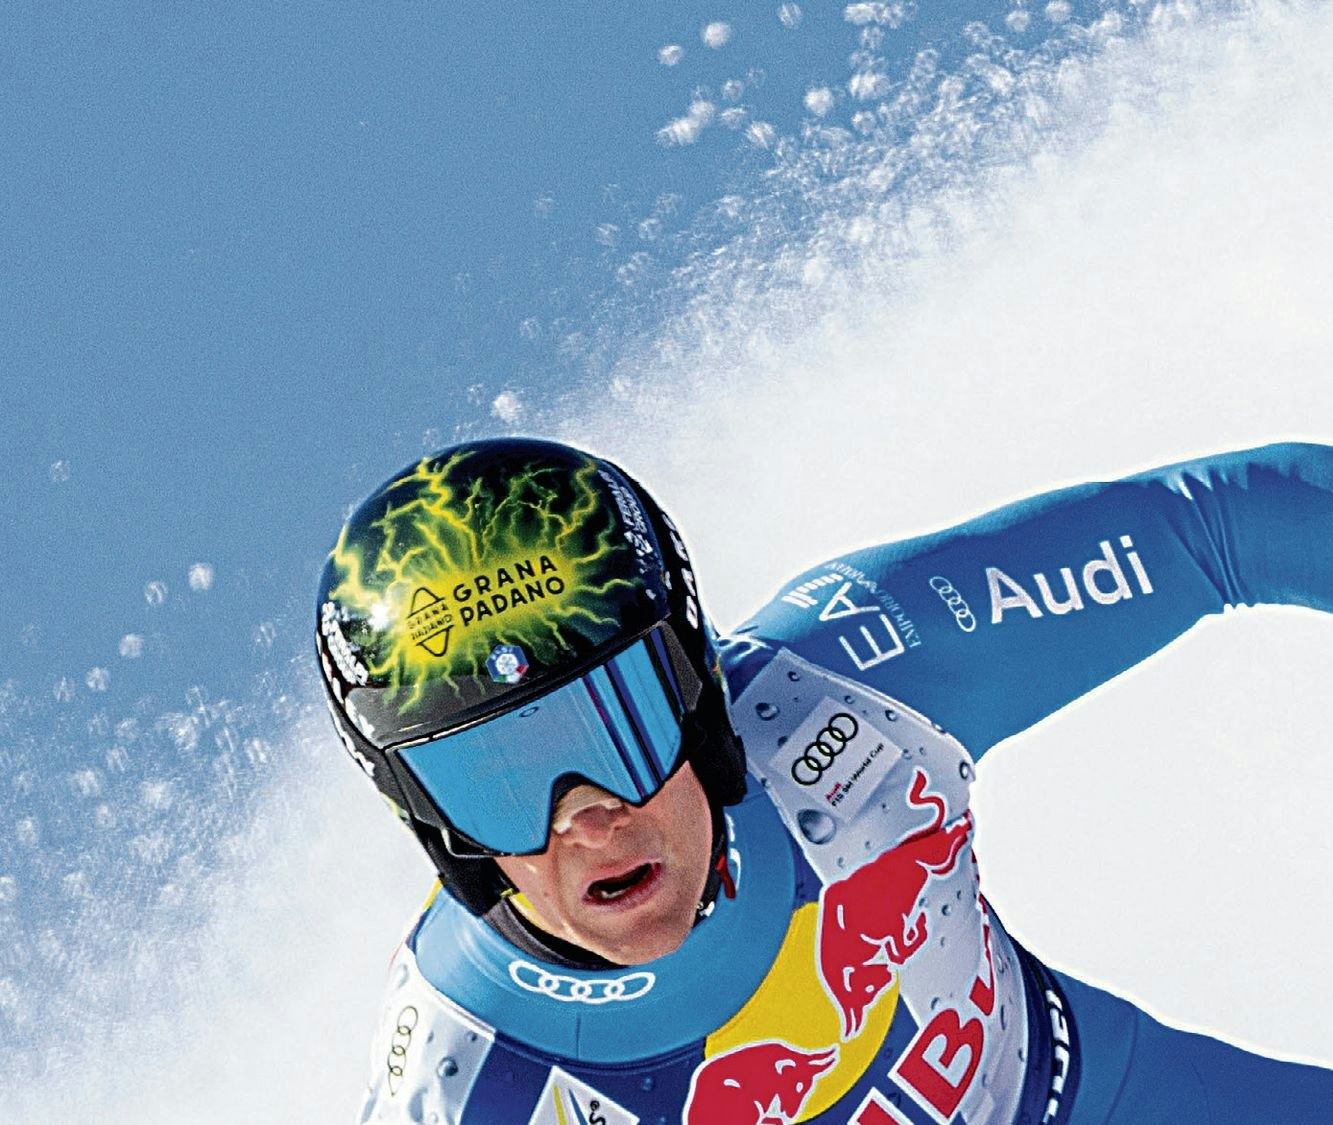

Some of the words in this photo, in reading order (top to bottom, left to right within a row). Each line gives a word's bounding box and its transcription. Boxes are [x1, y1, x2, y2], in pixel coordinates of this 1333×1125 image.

[453, 555, 557, 603] GRANA
[460, 576, 565, 627] PADANO
[987, 535, 1154, 624] Audi
